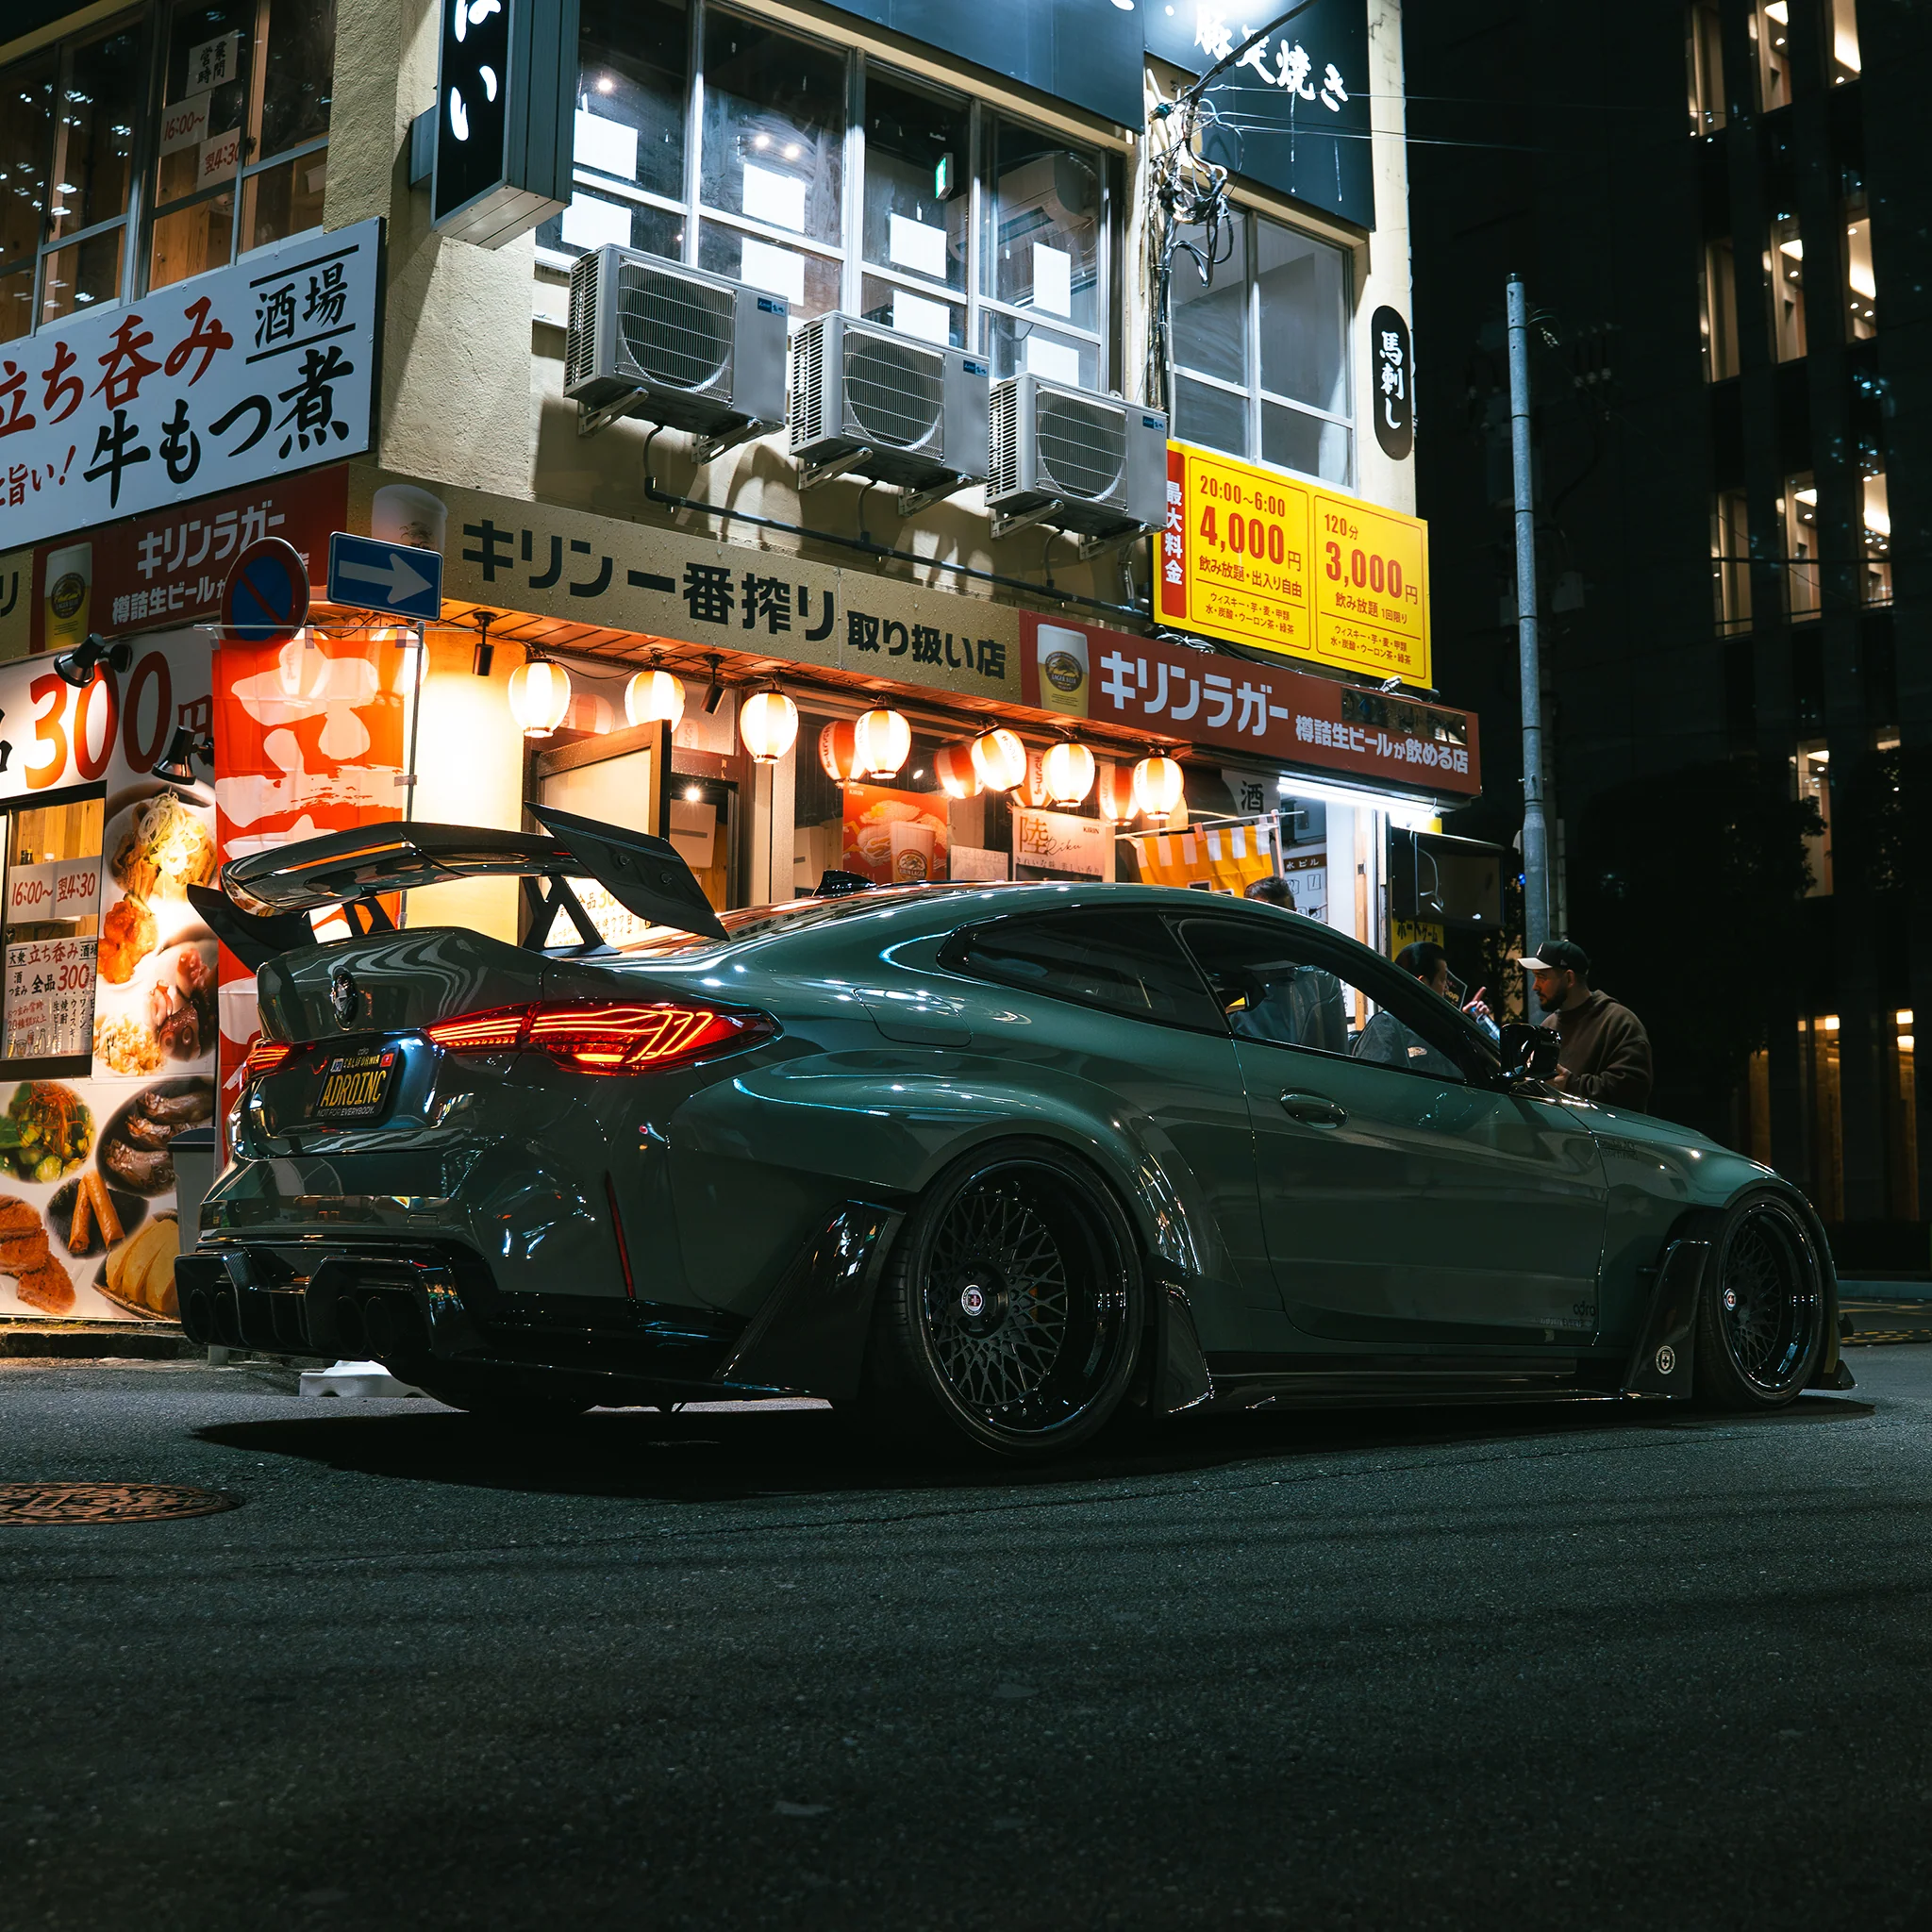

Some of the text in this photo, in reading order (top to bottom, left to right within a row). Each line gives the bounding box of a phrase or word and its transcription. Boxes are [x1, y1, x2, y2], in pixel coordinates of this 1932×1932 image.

[254, 261, 346, 349] 酒場
[1379, 331, 1405, 429] 馬刺し
[83, 346, 356, 510] 牛もつ煮
[137, 500, 286, 579] キリンラガー
[1165, 480, 1184, 586] 最大料金
[1200, 505, 1302, 573] 4,000円
[1324, 513, 1359, 541] 120分
[1325, 541, 1419, 606] 3,000円
[1335, 591, 1379, 618] 飲み放題
[847, 609, 1007, 679] 取り扱い店
[1100, 650, 1469, 774] キリンラガー 樽詰生ビールが飲める店
[1019, 816, 1049, 856] 陸
[14, 971, 24, 984] 酒
[28, 941, 79, 965] 立ち呑み
[31, 974, 56, 994] 全品
[343, 1054, 380, 1068] CALIFORNIA
